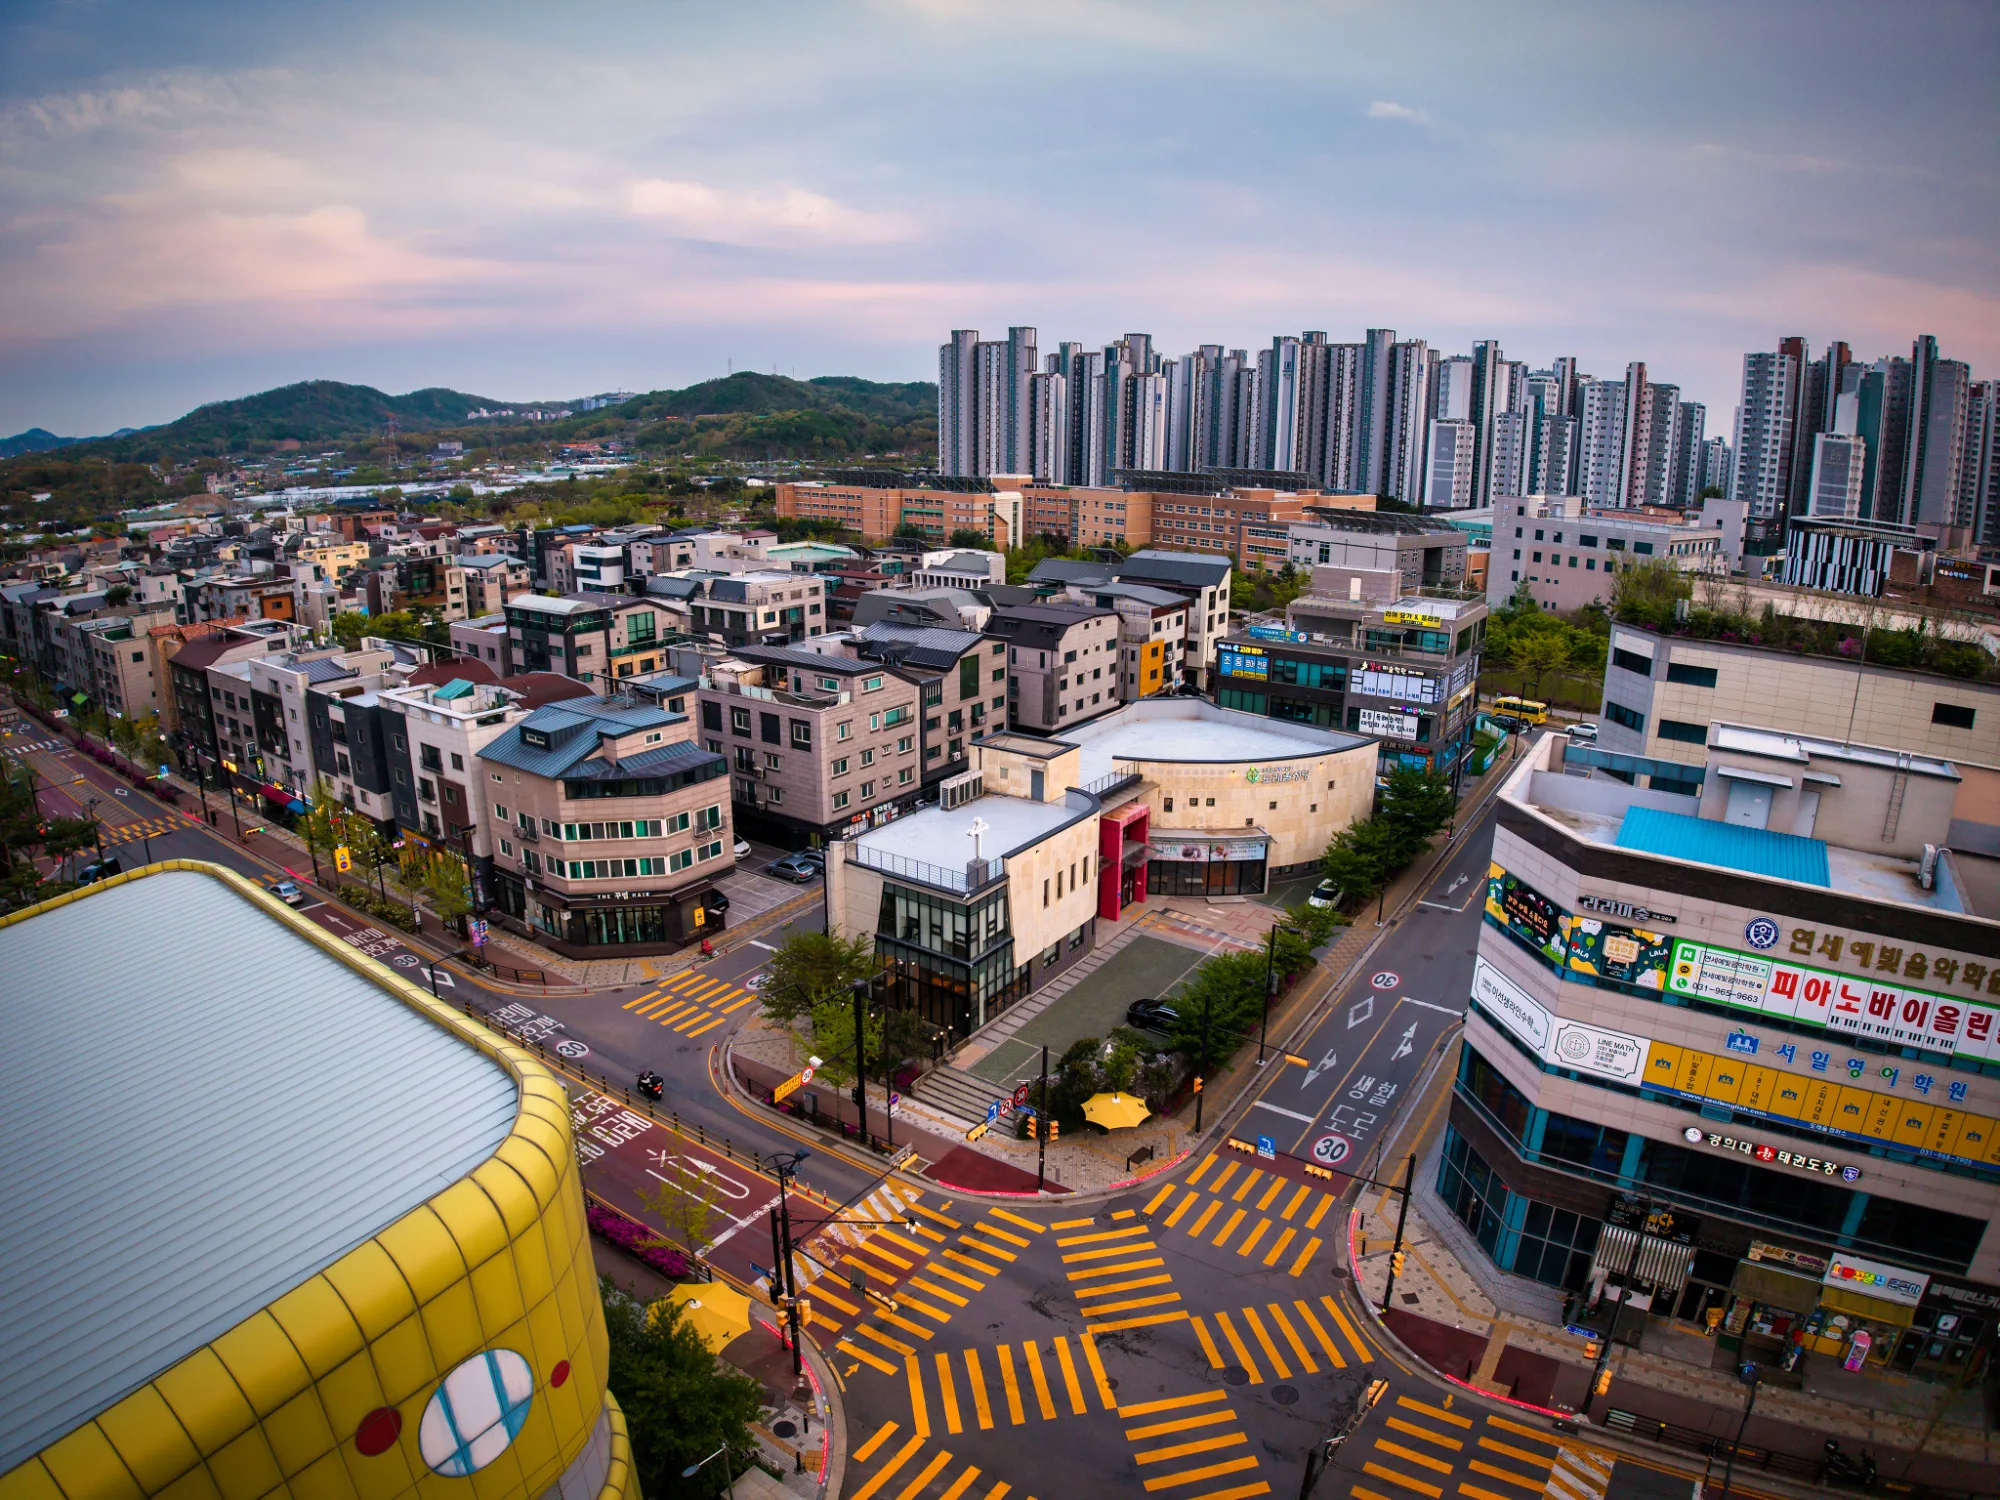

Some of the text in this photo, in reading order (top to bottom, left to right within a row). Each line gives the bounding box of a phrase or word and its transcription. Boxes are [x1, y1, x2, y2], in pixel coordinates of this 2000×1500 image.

[1583, 895, 1650, 923] 라라미술
[395, 955, 418, 967] 30
[1571, 945, 1589, 959] LALA
[1649, 948, 1668, 958] LALA
[1703, 955, 1759, 973] 연세예빛음악학원
[1373, 973, 1398, 988] 30
[1701, 970, 1756, 989] 연세예빛음악학원
[1692, 982, 1759, 1003] 031-965-9663
[1491, 986, 1534, 1029] 이선생라인수학
[558, 1042, 587, 1057] 30
[1597, 1038, 1635, 1052] LINE MATH
[1732, 1043, 1752, 1053] English
[1348, 1075, 1399, 1107] 생활
[1679, 1090, 1767, 1117] www.seoilenglish.com
[588, 1110, 654, 1148] 어린이
[1324, 1104, 1378, 1140] 도로
[1315, 1138, 1347, 1161] 30
[1708, 1133, 1838, 1176] 경희대 태권도장
[1887, 1278, 1921, 1295] 문구야
